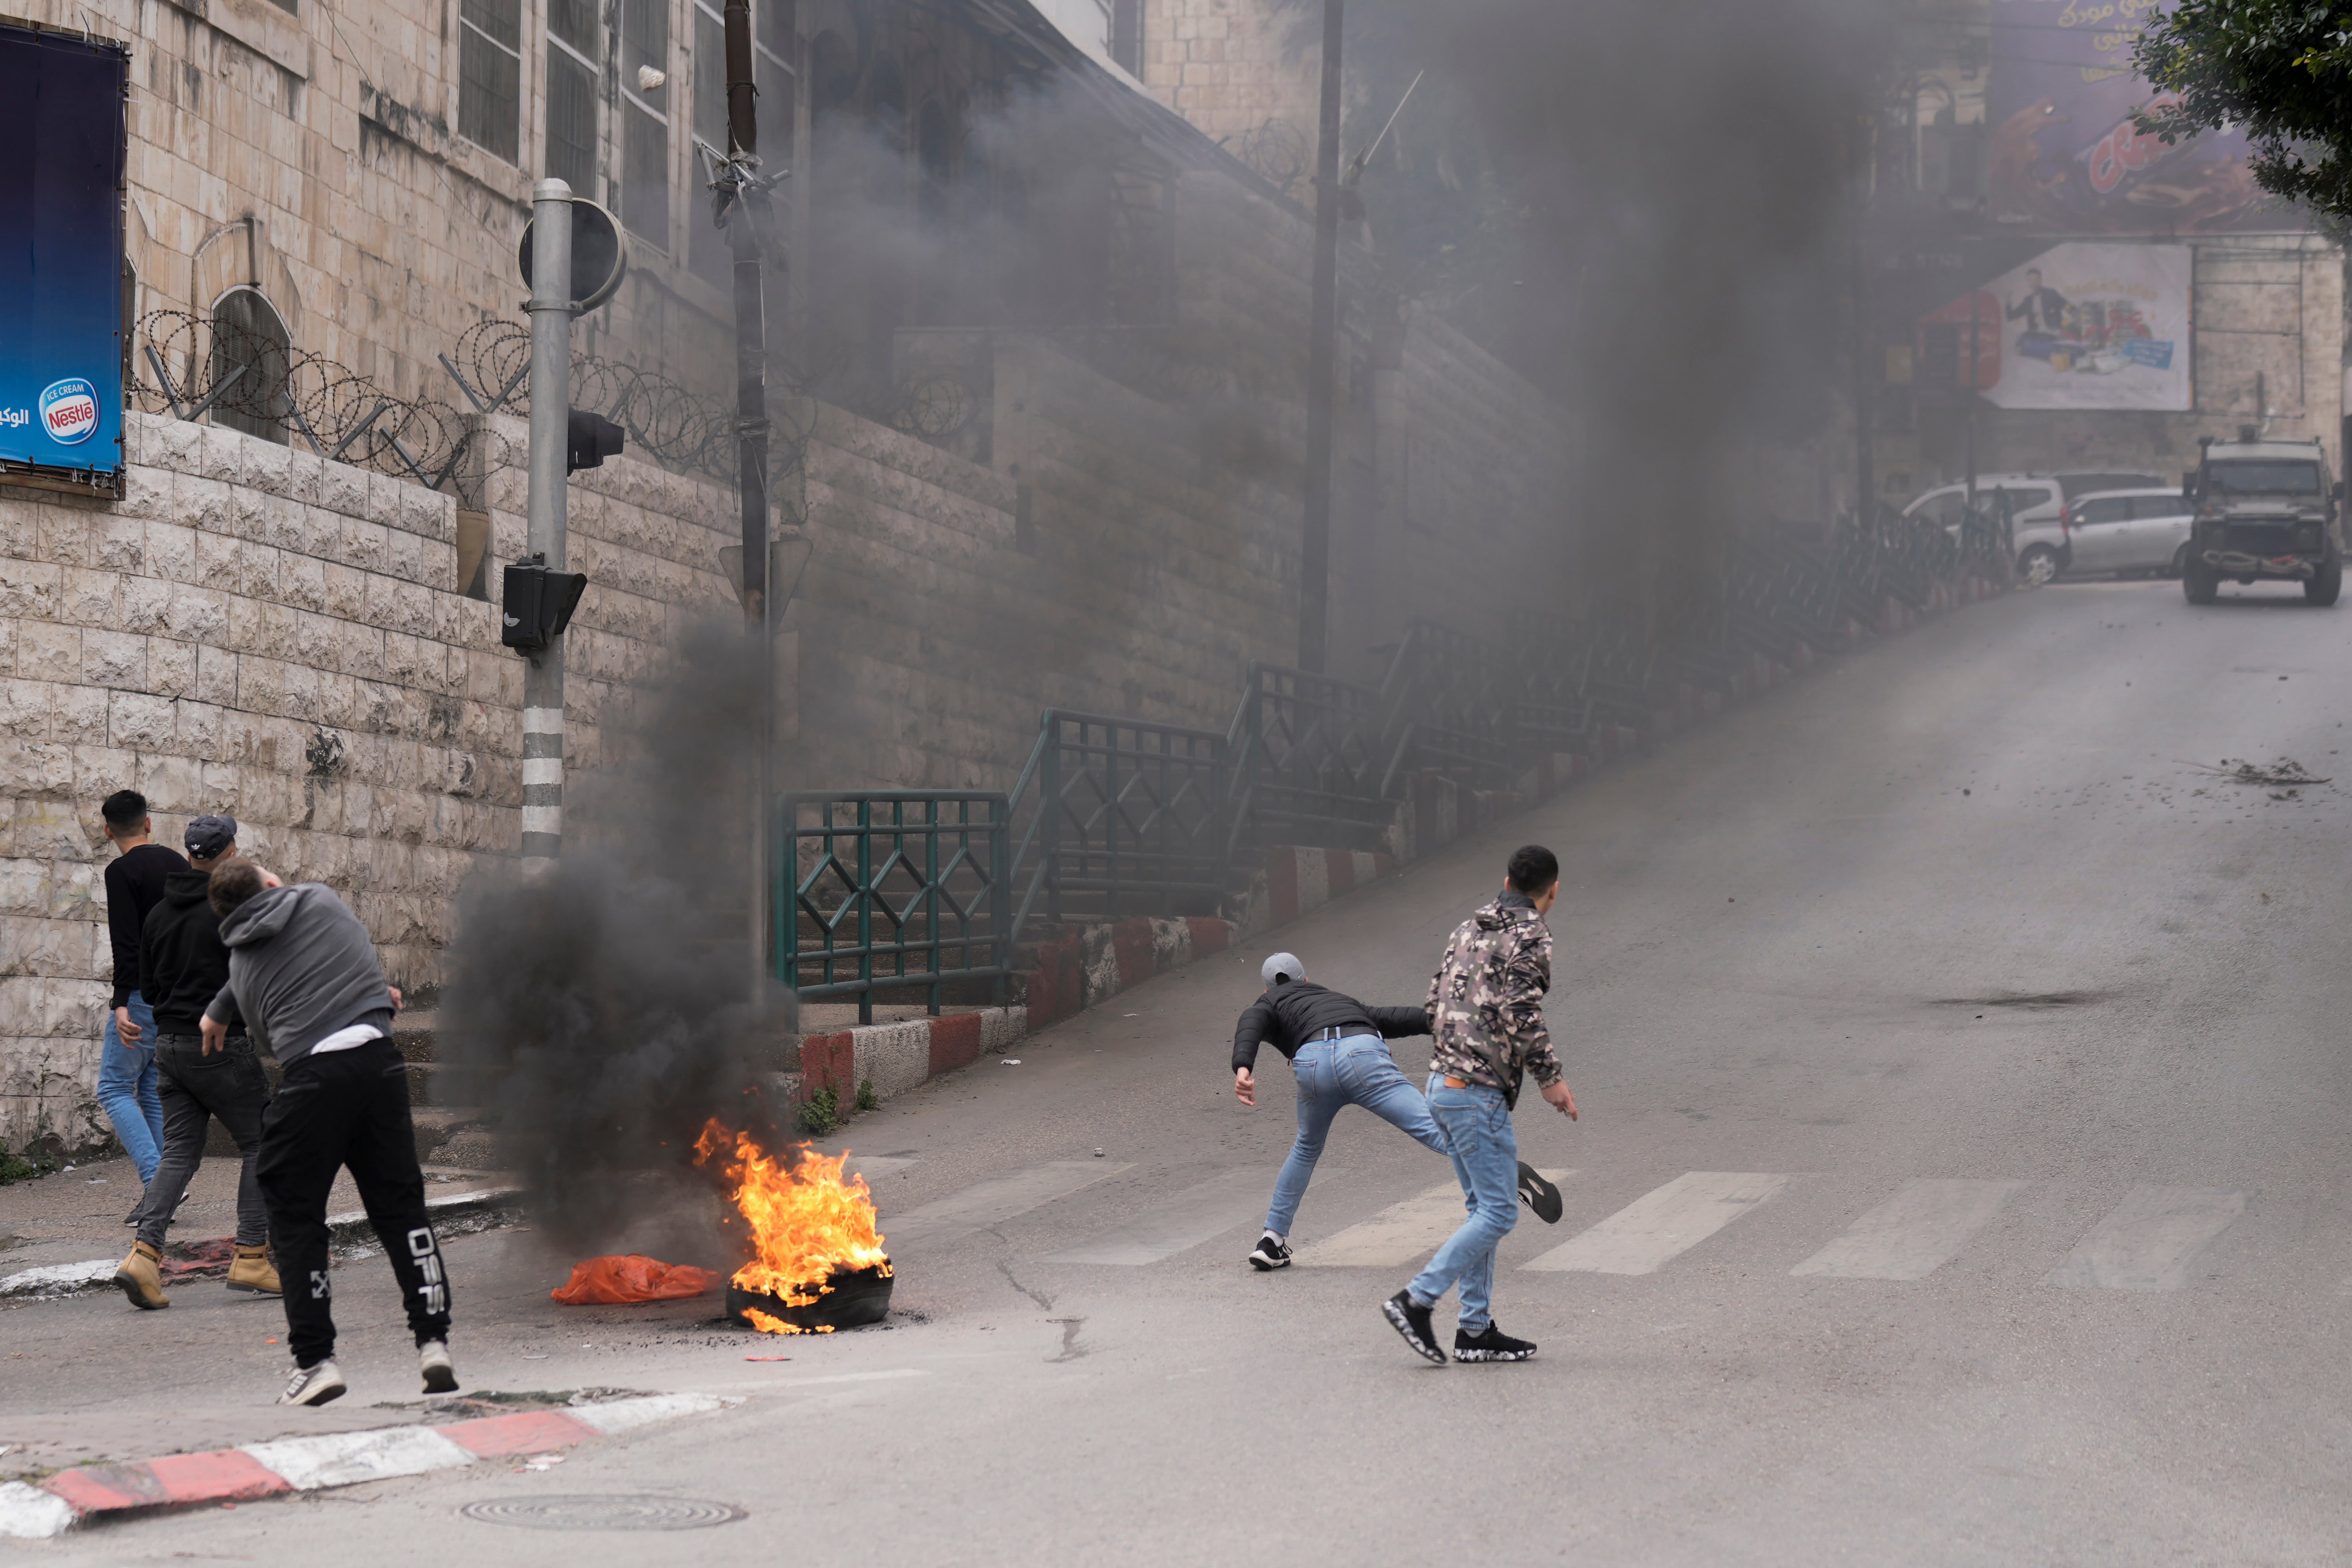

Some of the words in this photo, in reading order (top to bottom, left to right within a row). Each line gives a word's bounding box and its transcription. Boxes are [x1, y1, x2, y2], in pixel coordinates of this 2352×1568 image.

[47, 390, 58, 401] ICE
[59, 384, 84, 396] CREAM
[408, 1227, 445, 1315] OFF
